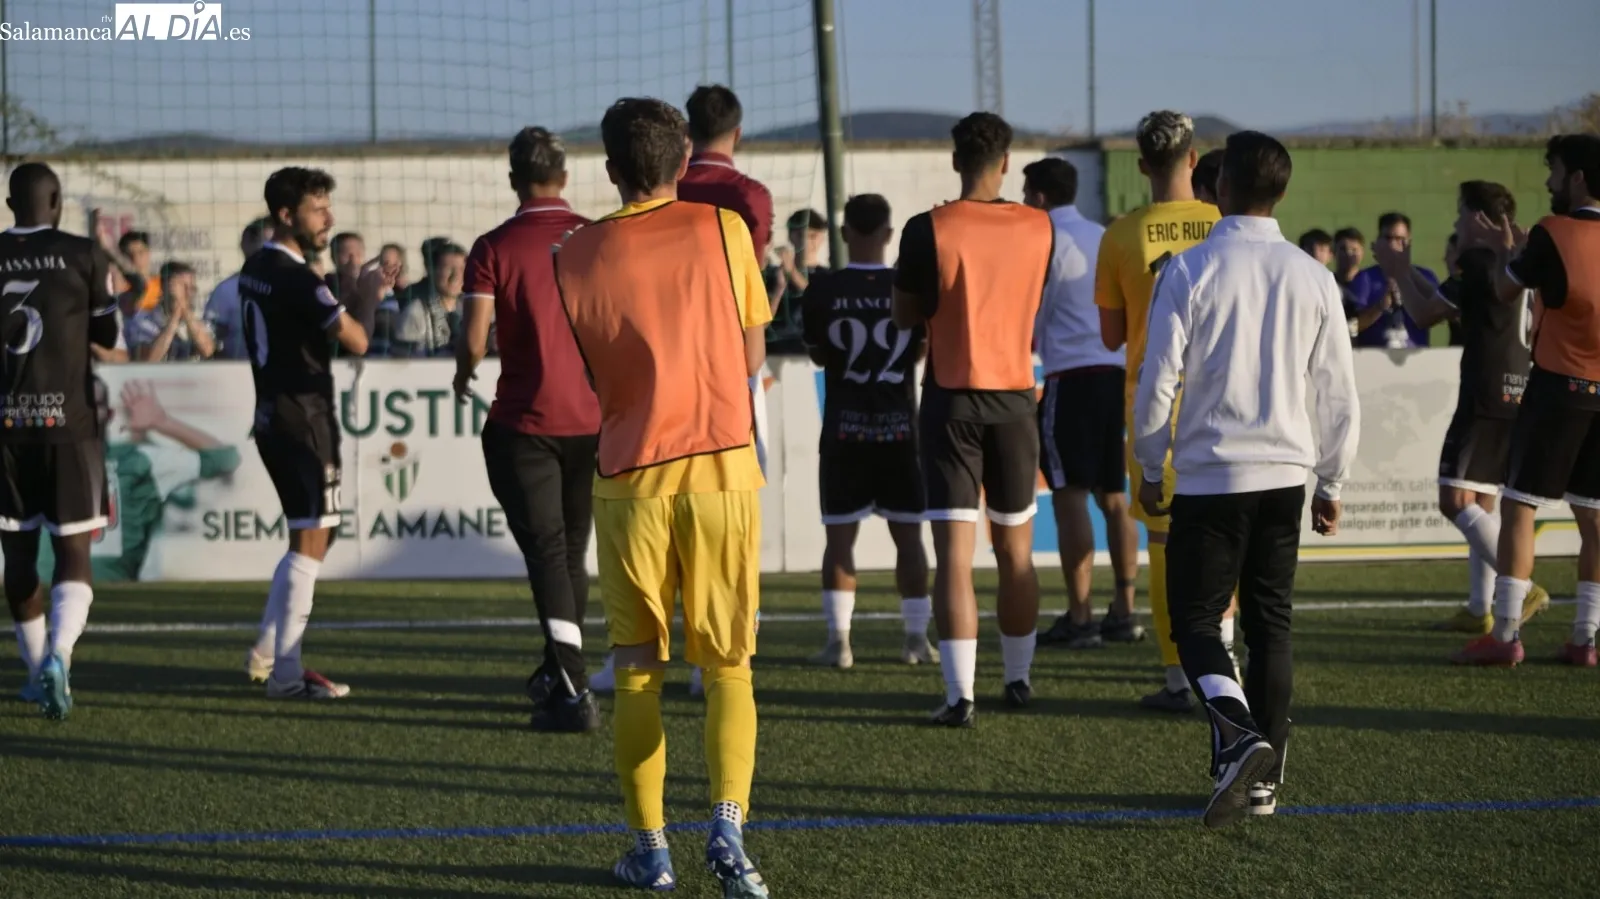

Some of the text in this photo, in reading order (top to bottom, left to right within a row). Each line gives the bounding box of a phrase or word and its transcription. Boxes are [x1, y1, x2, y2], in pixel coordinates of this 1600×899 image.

[1147, 221, 1179, 243] ERIC
[0, 256, 67, 272] ASSAMA
[2, 279, 43, 355] 3
[828, 316, 912, 384] 22
[1402, 500, 1428, 515] para
[1389, 516, 1422, 531] parte
